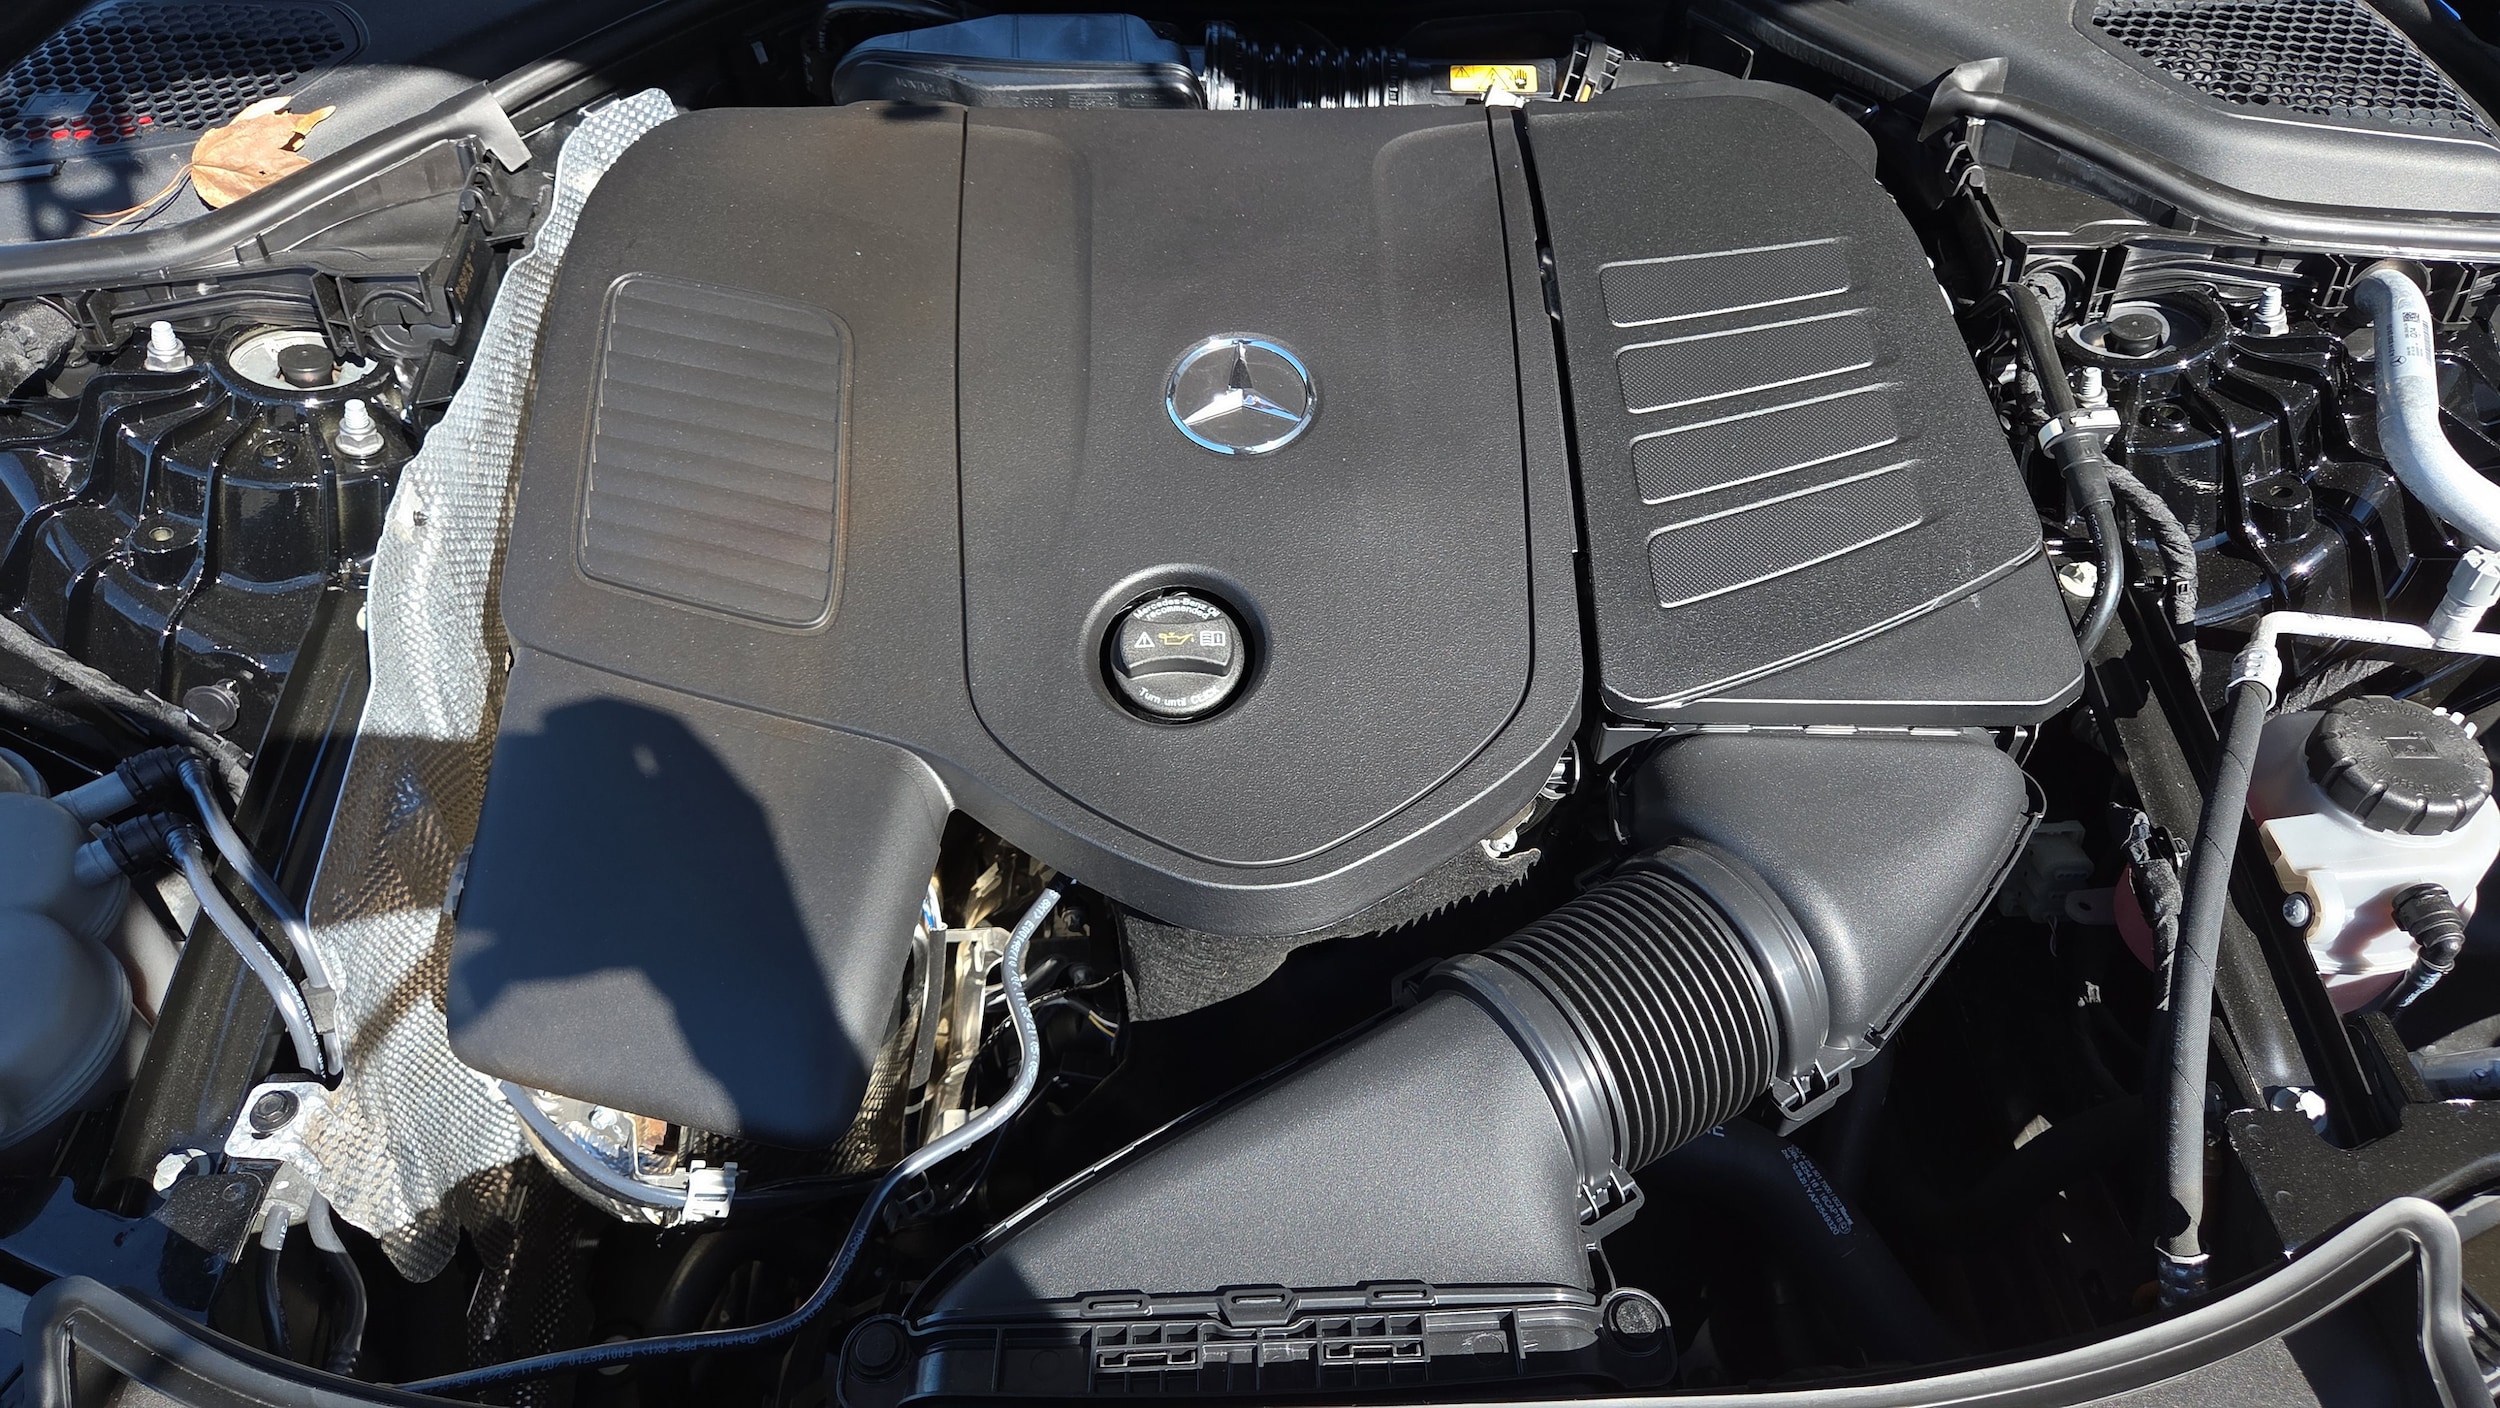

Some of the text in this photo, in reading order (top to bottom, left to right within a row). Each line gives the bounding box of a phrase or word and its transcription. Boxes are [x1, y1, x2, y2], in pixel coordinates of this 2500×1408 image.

[1134, 599, 1221, 619] Mercedes-Benz Oil
[1146, 607, 1211, 620] recommended
[1139, 687, 1161, 704] Turn
[1164, 697, 1187, 707] until
